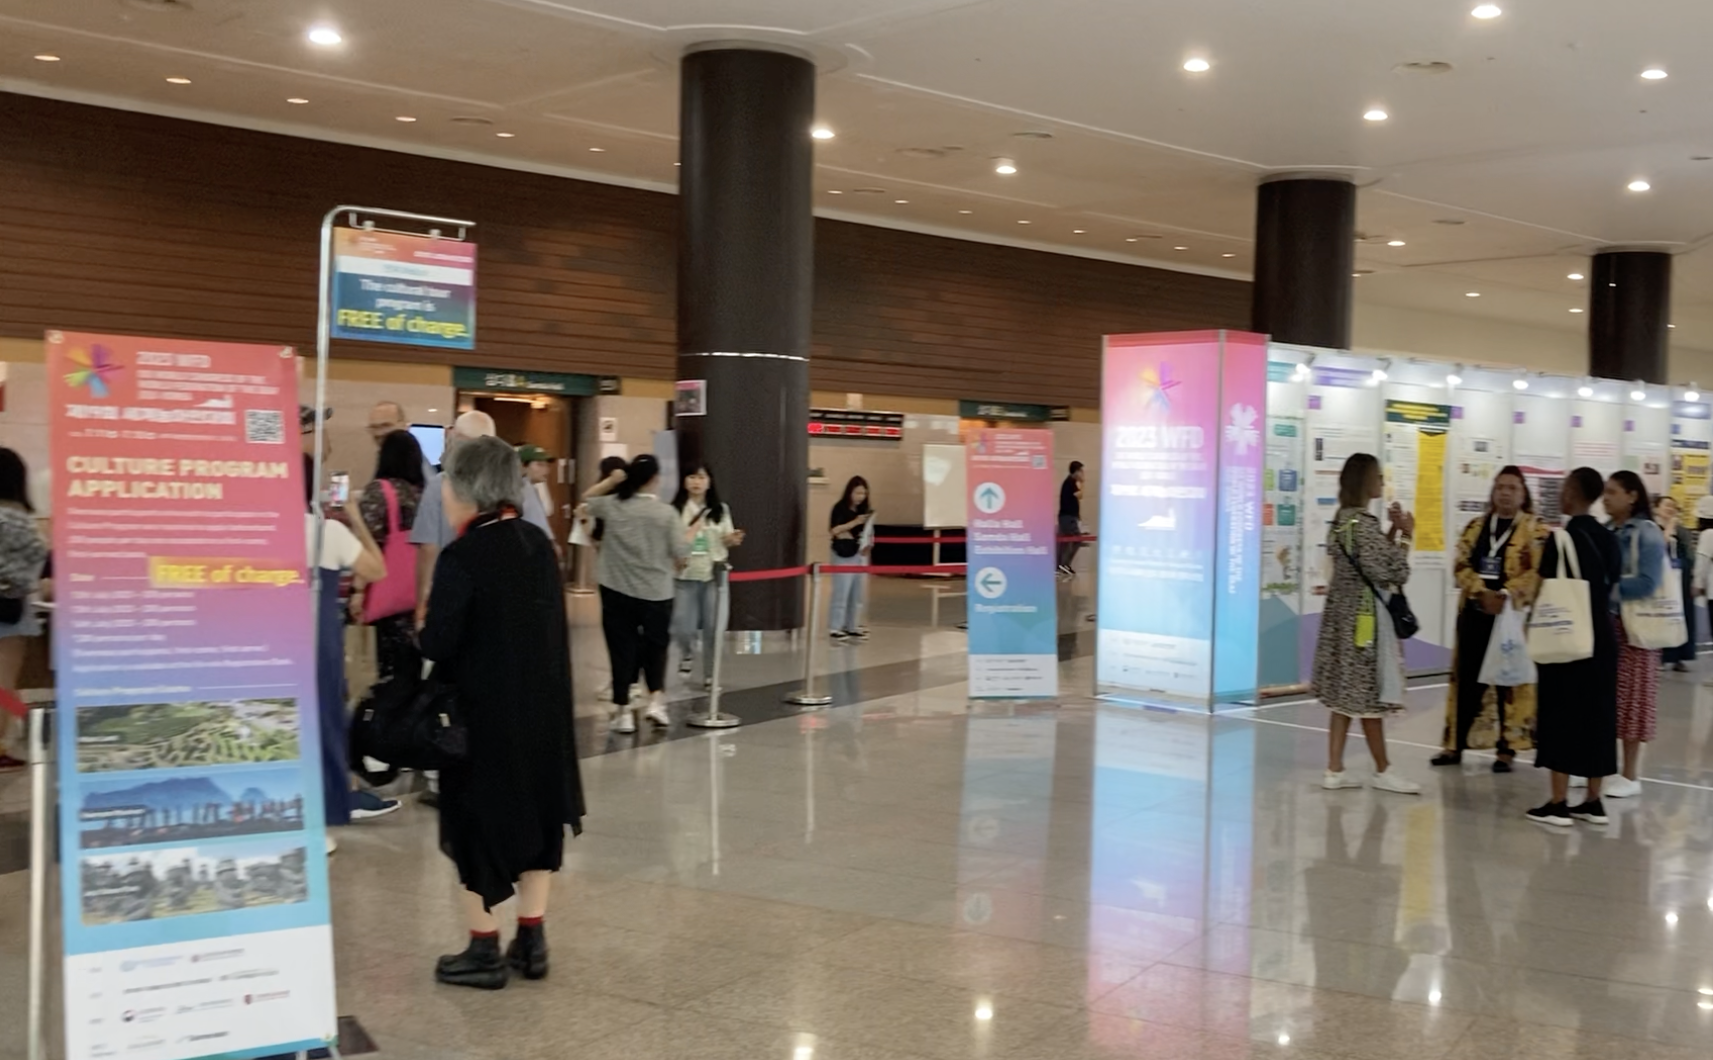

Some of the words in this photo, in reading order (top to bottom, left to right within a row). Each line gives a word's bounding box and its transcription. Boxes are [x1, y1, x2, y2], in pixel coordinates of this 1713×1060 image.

[337, 308, 384, 329] FREE
[385, 313, 407, 330] of
[66, 455, 176, 476] CULTURE
[179, 459, 289, 478] PROGRAM
[67, 479, 223, 499] APPLICATION
[156, 564, 208, 583] FREE
[210, 564, 234, 583] of
